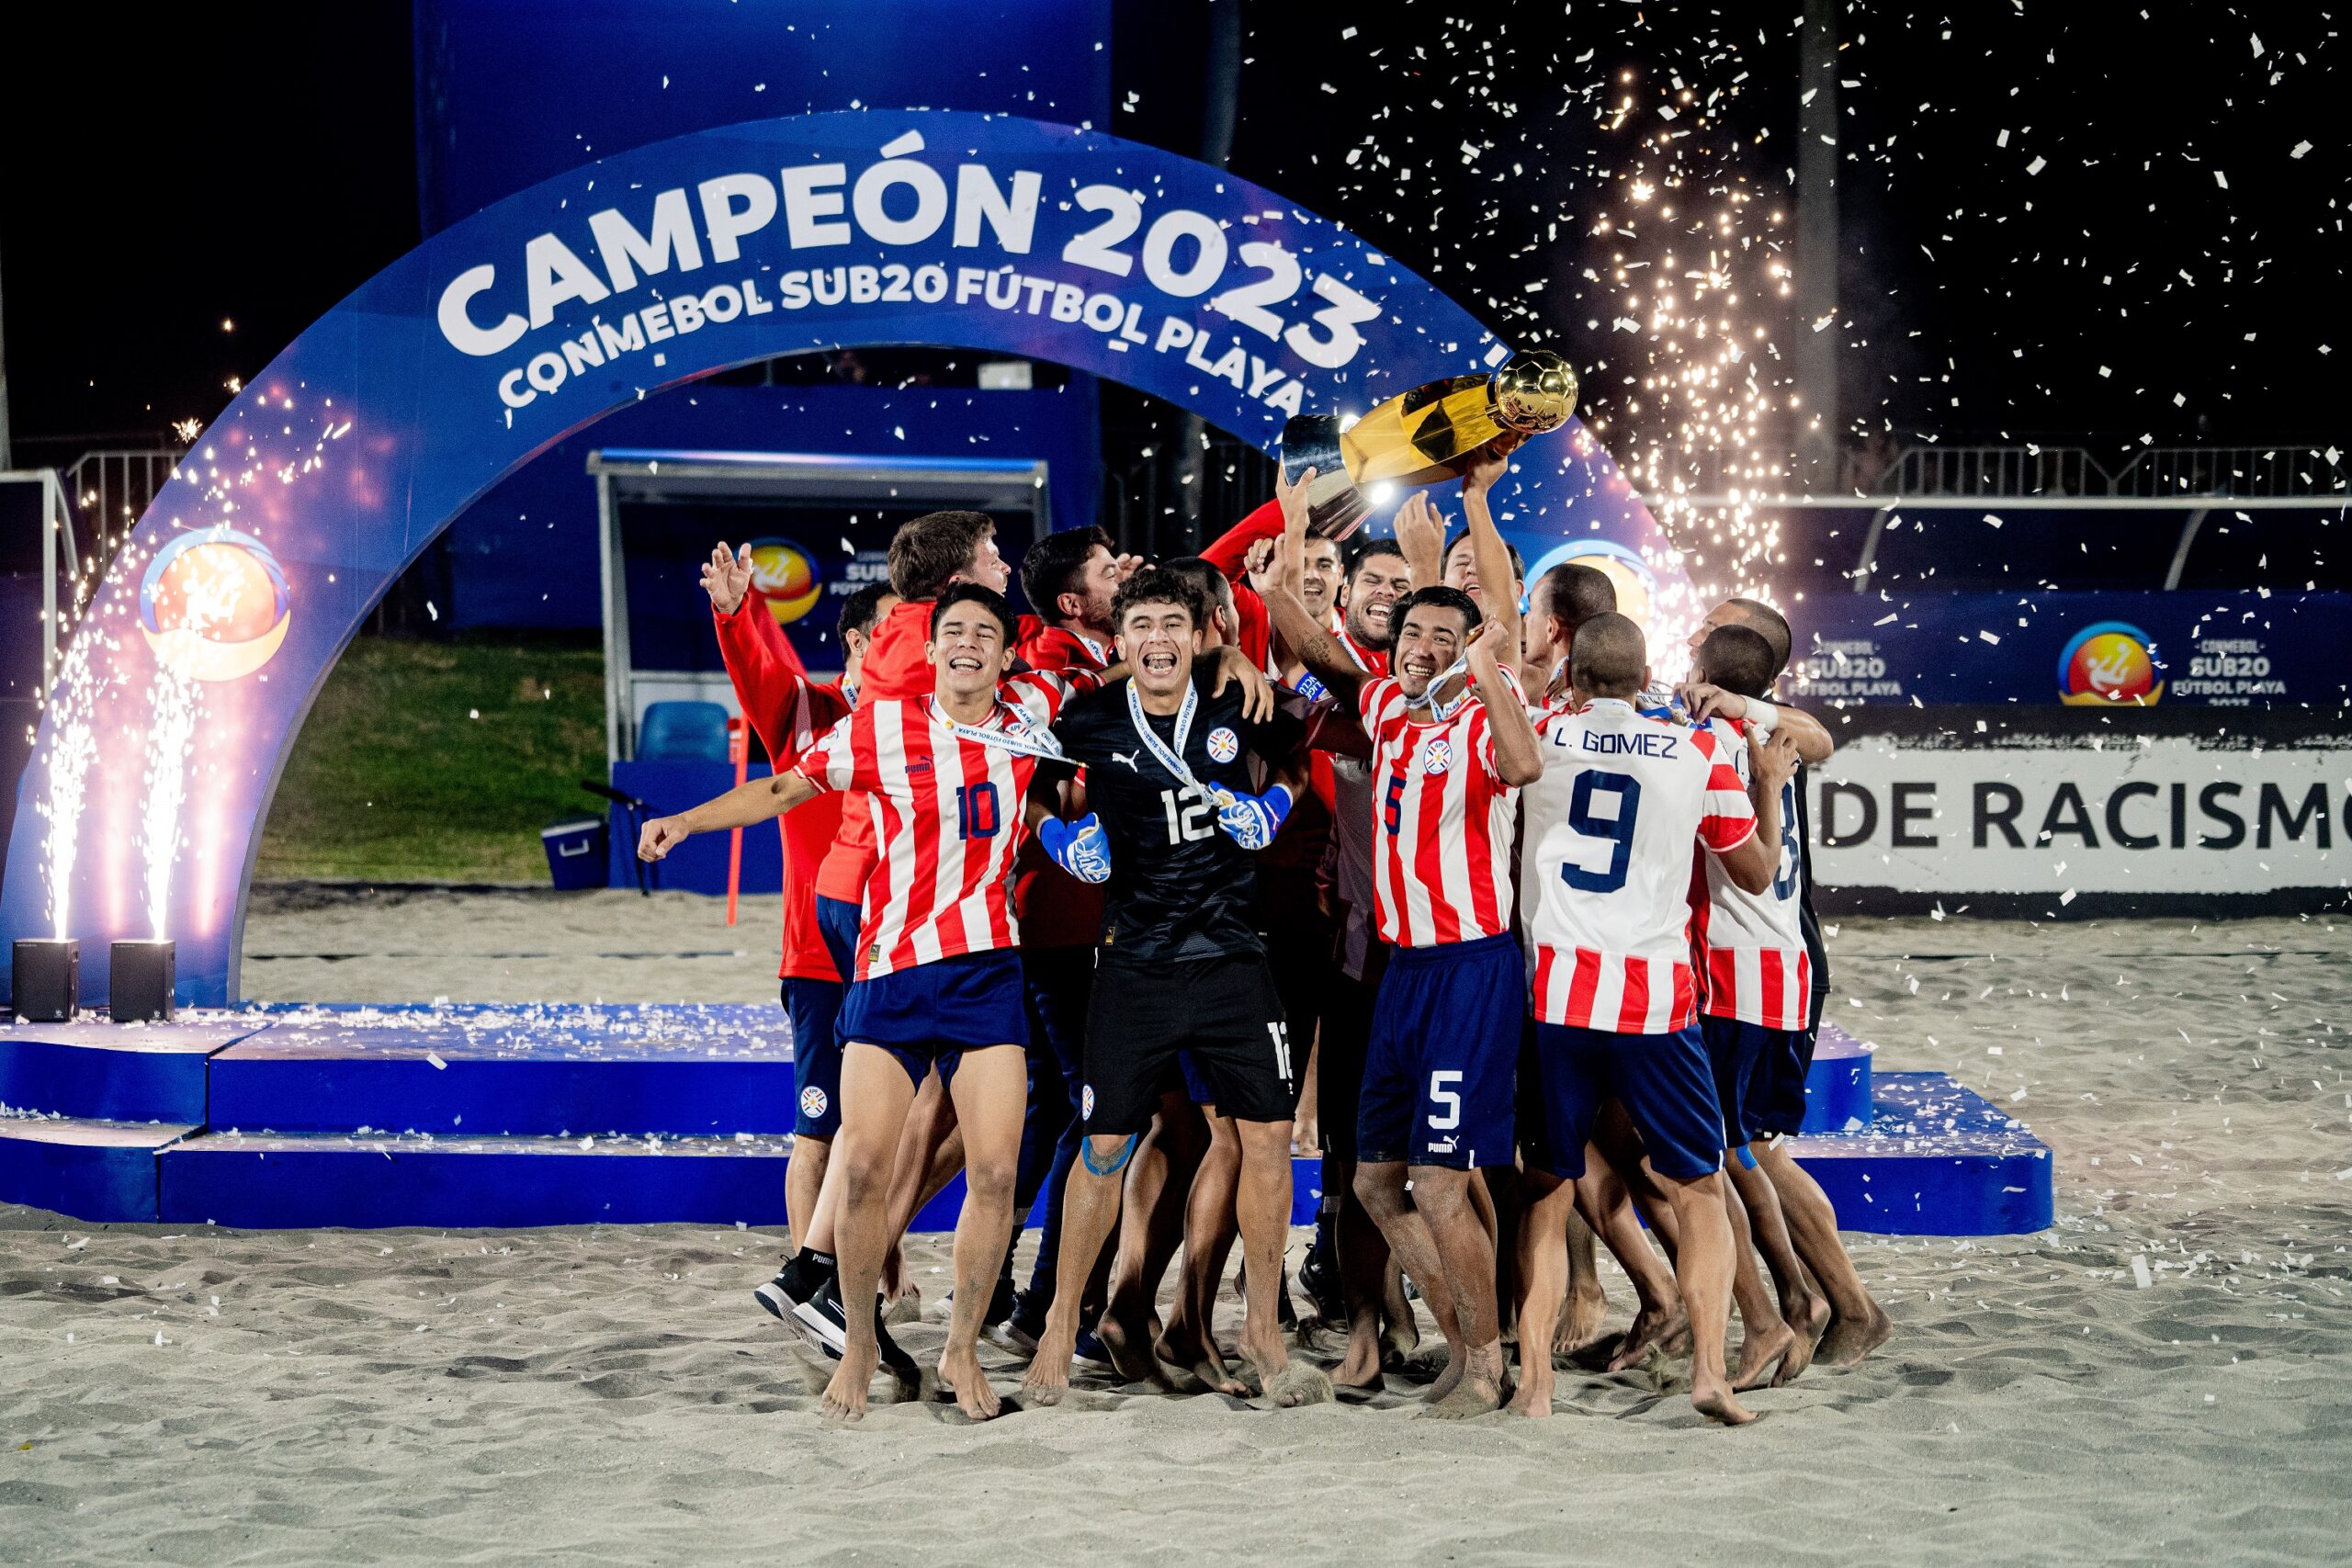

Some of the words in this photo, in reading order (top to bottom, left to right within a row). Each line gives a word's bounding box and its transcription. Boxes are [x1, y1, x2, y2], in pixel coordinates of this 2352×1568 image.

[437, 129, 1043, 356] CAMPEÓN
[1061, 184, 1383, 368] 2023
[498, 279, 773, 408] CONMEBOL
[779, 264, 948, 309] SUB20
[956, 265, 1148, 344] FÚTBOL
[1155, 317, 1304, 418] PLAYA
[1850, 680, 1902, 696] PLAYA
[2190, 657, 2270, 677] SUB20
[2235, 681, 2286, 694] PLAYA
[1158, 747, 1184, 775] CONMEBOL
[1555, 728, 1574, 748] L.
[1582, 729, 1679, 760] GOMEZ
[905, 761, 931, 773] PUMA
[956, 781, 1001, 840] 10
[1160, 788, 1216, 846] 12
[1384, 774, 1408, 836] 5
[1819, 781, 1939, 850] DE
[1972, 780, 2352, 851] RACISM
[1560, 768, 1642, 894] 9
[1427, 1070, 1464, 1130] 5
[1428, 1142, 1453, 1154] PUMA
[812, 1253, 834, 1267] PUMA
